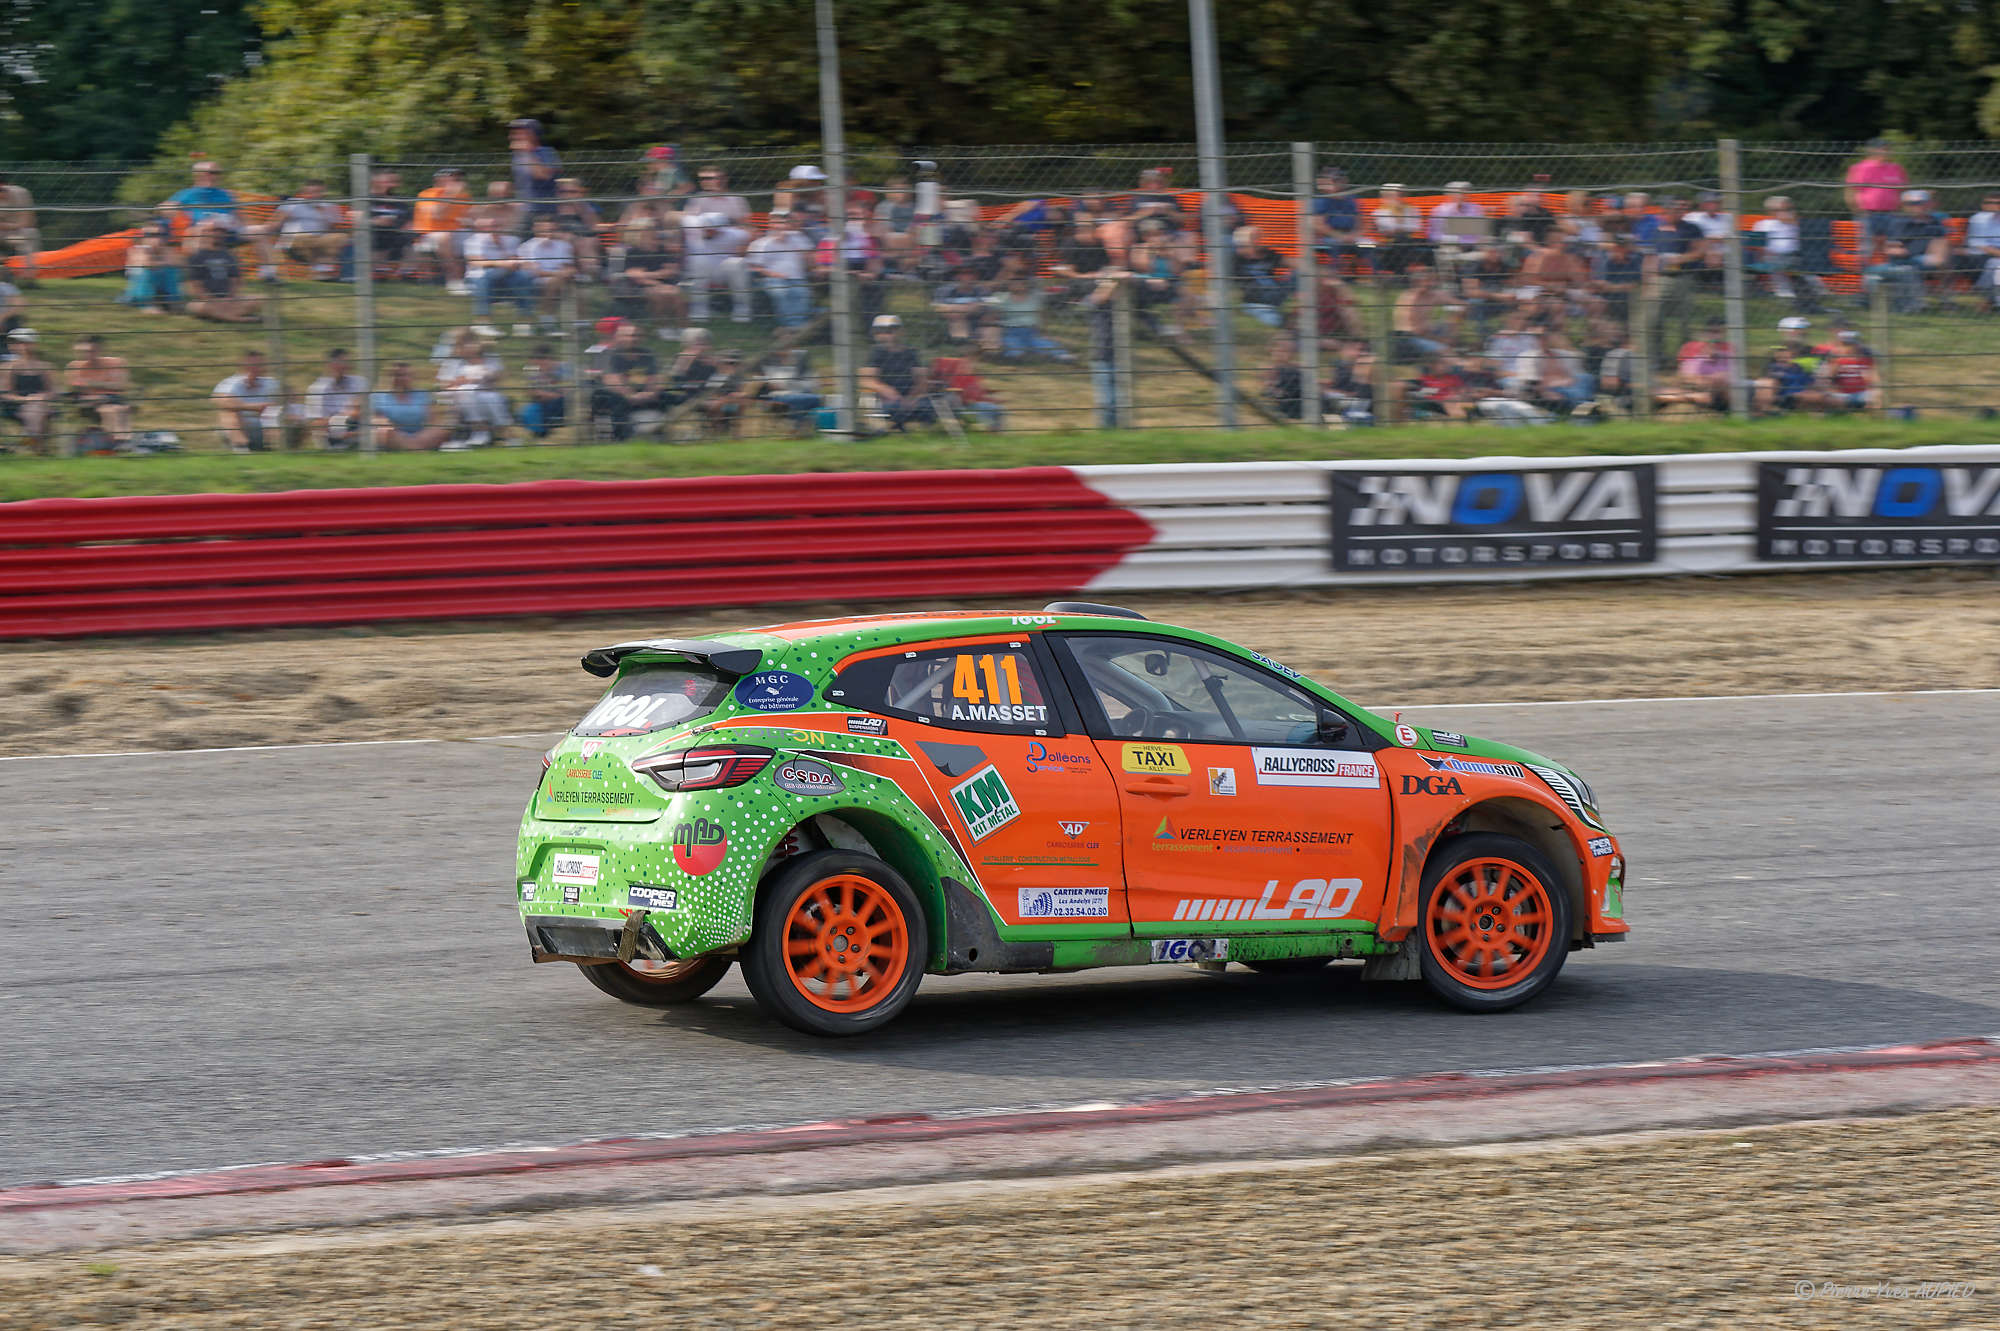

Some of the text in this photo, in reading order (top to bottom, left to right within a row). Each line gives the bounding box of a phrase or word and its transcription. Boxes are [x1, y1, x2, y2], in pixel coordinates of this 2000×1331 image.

[1352, 471, 1641, 526] NOVA
[1348, 542, 1641, 566] MOTORSPORT
[755, 675, 789, 685] MGC
[953, 654, 1022, 704] 411
[580, 694, 667, 728] IGOL
[952, 705, 1047, 721] A.MASSET
[1399, 727, 1413, 741] E
[1132, 751, 1175, 767] TAXI
[1264, 757, 1375, 777] RALLYCROSS FRANCE
[782, 767, 835, 785] CSDA
[1401, 775, 1465, 795] DGA
[554, 791, 635, 804] VERLEYEN TERRASSEMENT
[955, 769, 1010, 825] KM
[972, 820, 988, 837] KIT
[1064, 823, 1083, 835] AD
[1180, 828, 1353, 844] VERLEYEN TERRASSEMENT
[674, 818, 725, 858] MAD
[630, 886, 676, 900] COOPER
[1054, 888, 1108, 896] CARTIER PNEUS
[1253, 878, 1362, 920] LAD
[650, 898, 674, 907] TIRES
